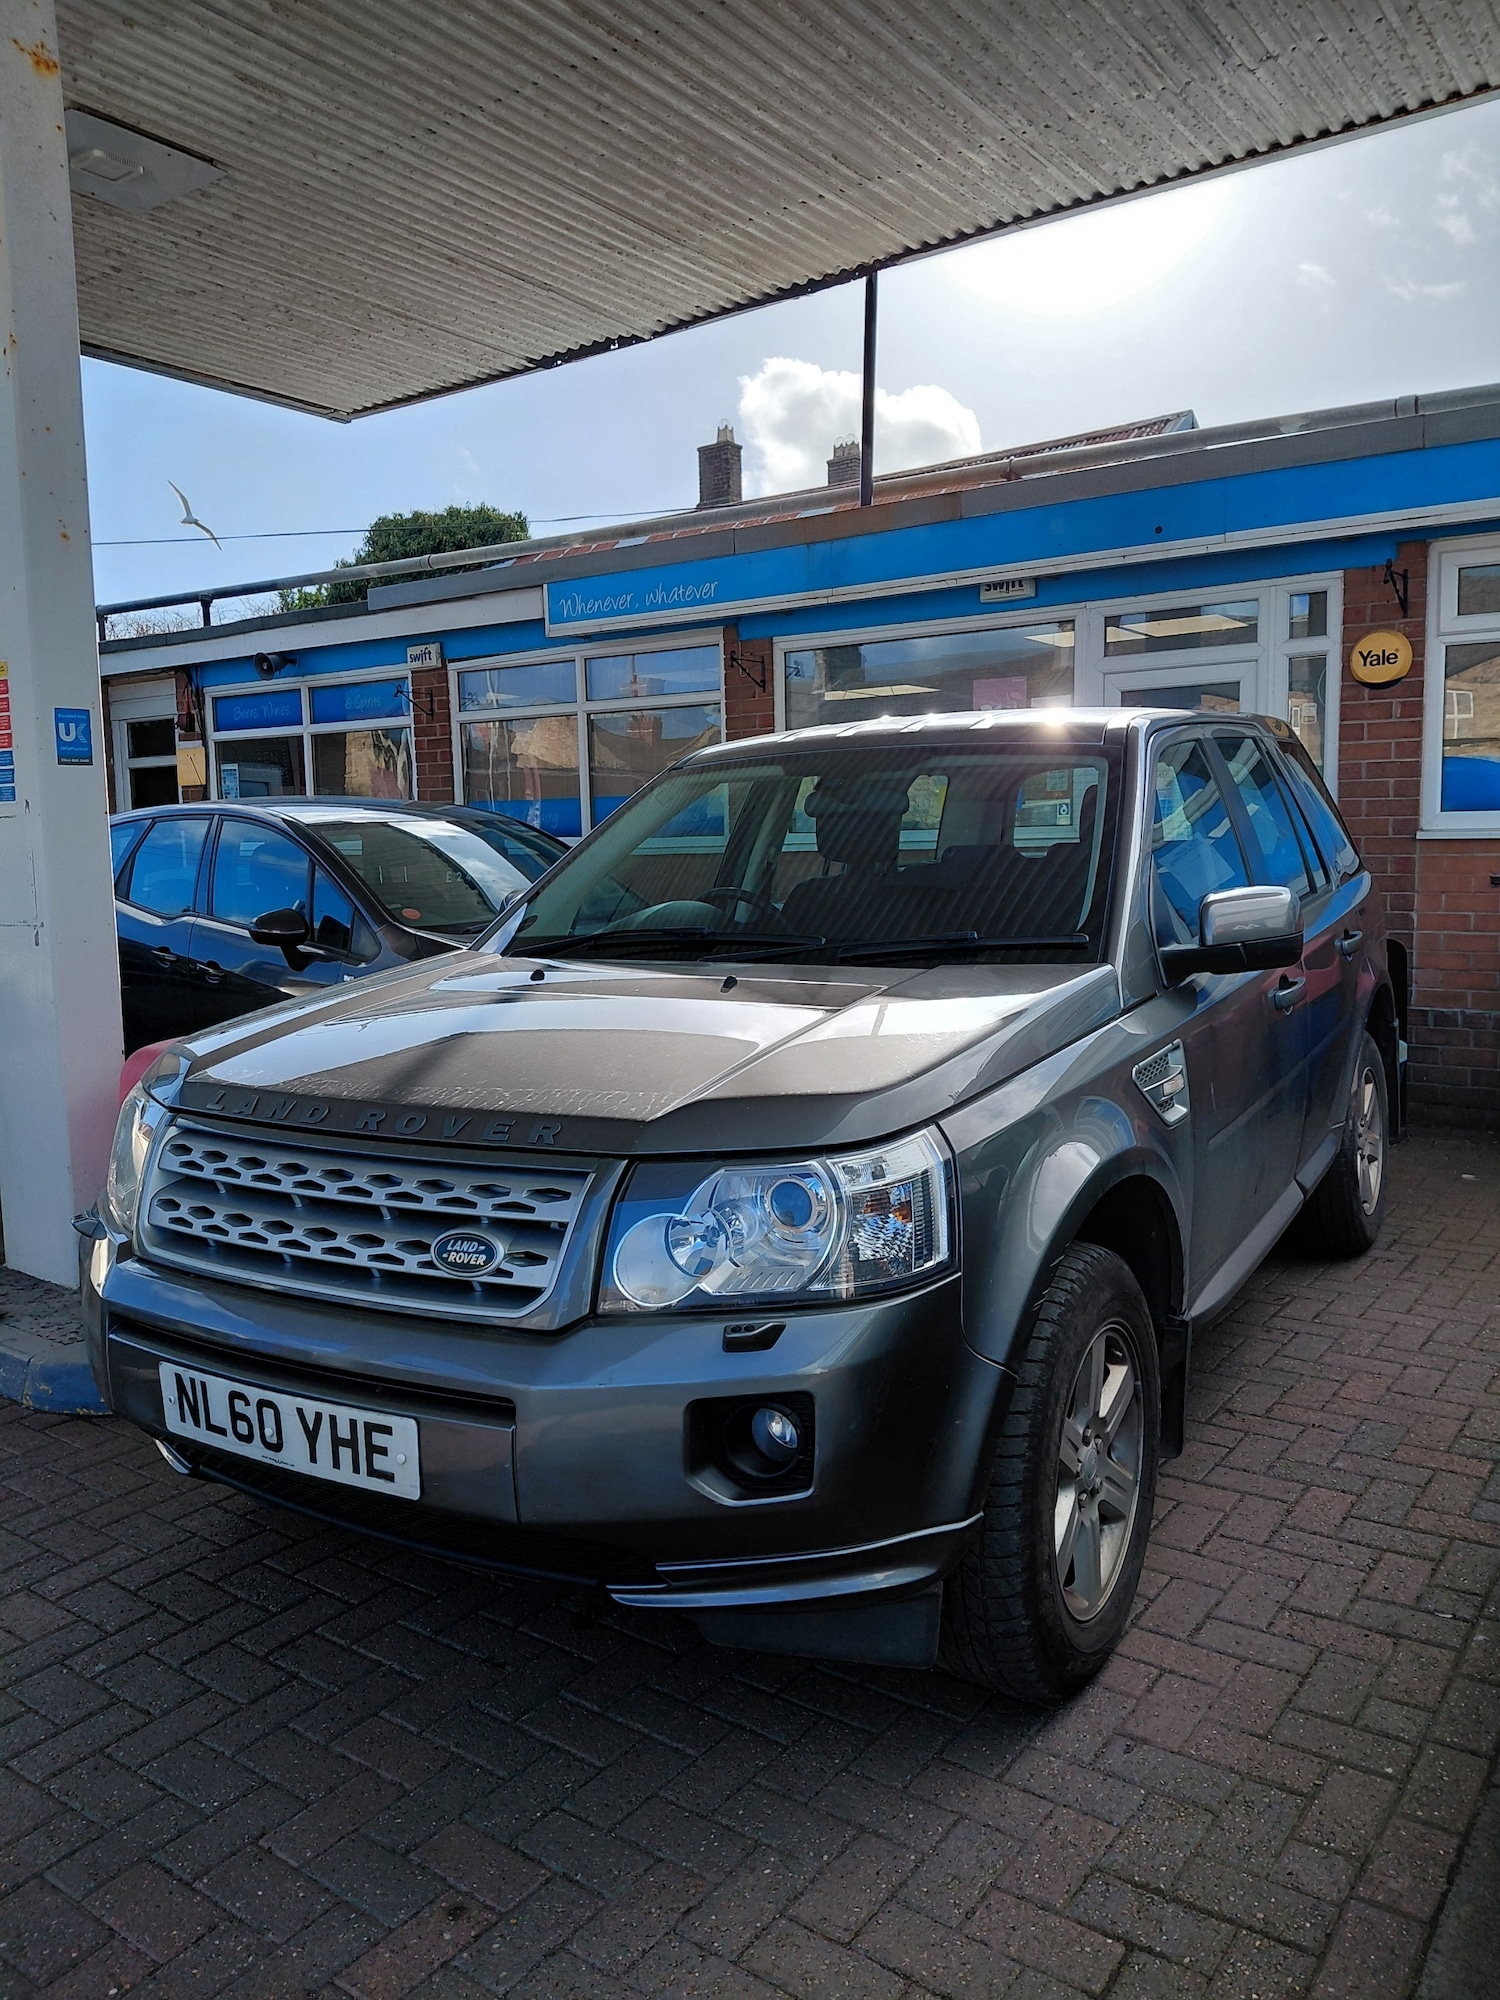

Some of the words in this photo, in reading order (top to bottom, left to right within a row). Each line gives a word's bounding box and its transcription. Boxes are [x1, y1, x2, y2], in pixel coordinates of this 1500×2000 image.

[645, 580, 719, 605] whatever
[409, 646, 433, 665] swift
[1358, 649, 1399, 667] Yale
[264, 700, 290, 718] Wines
[355, 695, 382, 710] Spirits
[203, 1089, 330, 1125] LAND
[355, 1108, 562, 1145] ROVER
[447, 1241, 479, 1253] LAND
[447, 1252, 487, 1266] ROVER
[174, 1372, 284, 1453] NL60
[296, 1407, 395, 1483] YHE
